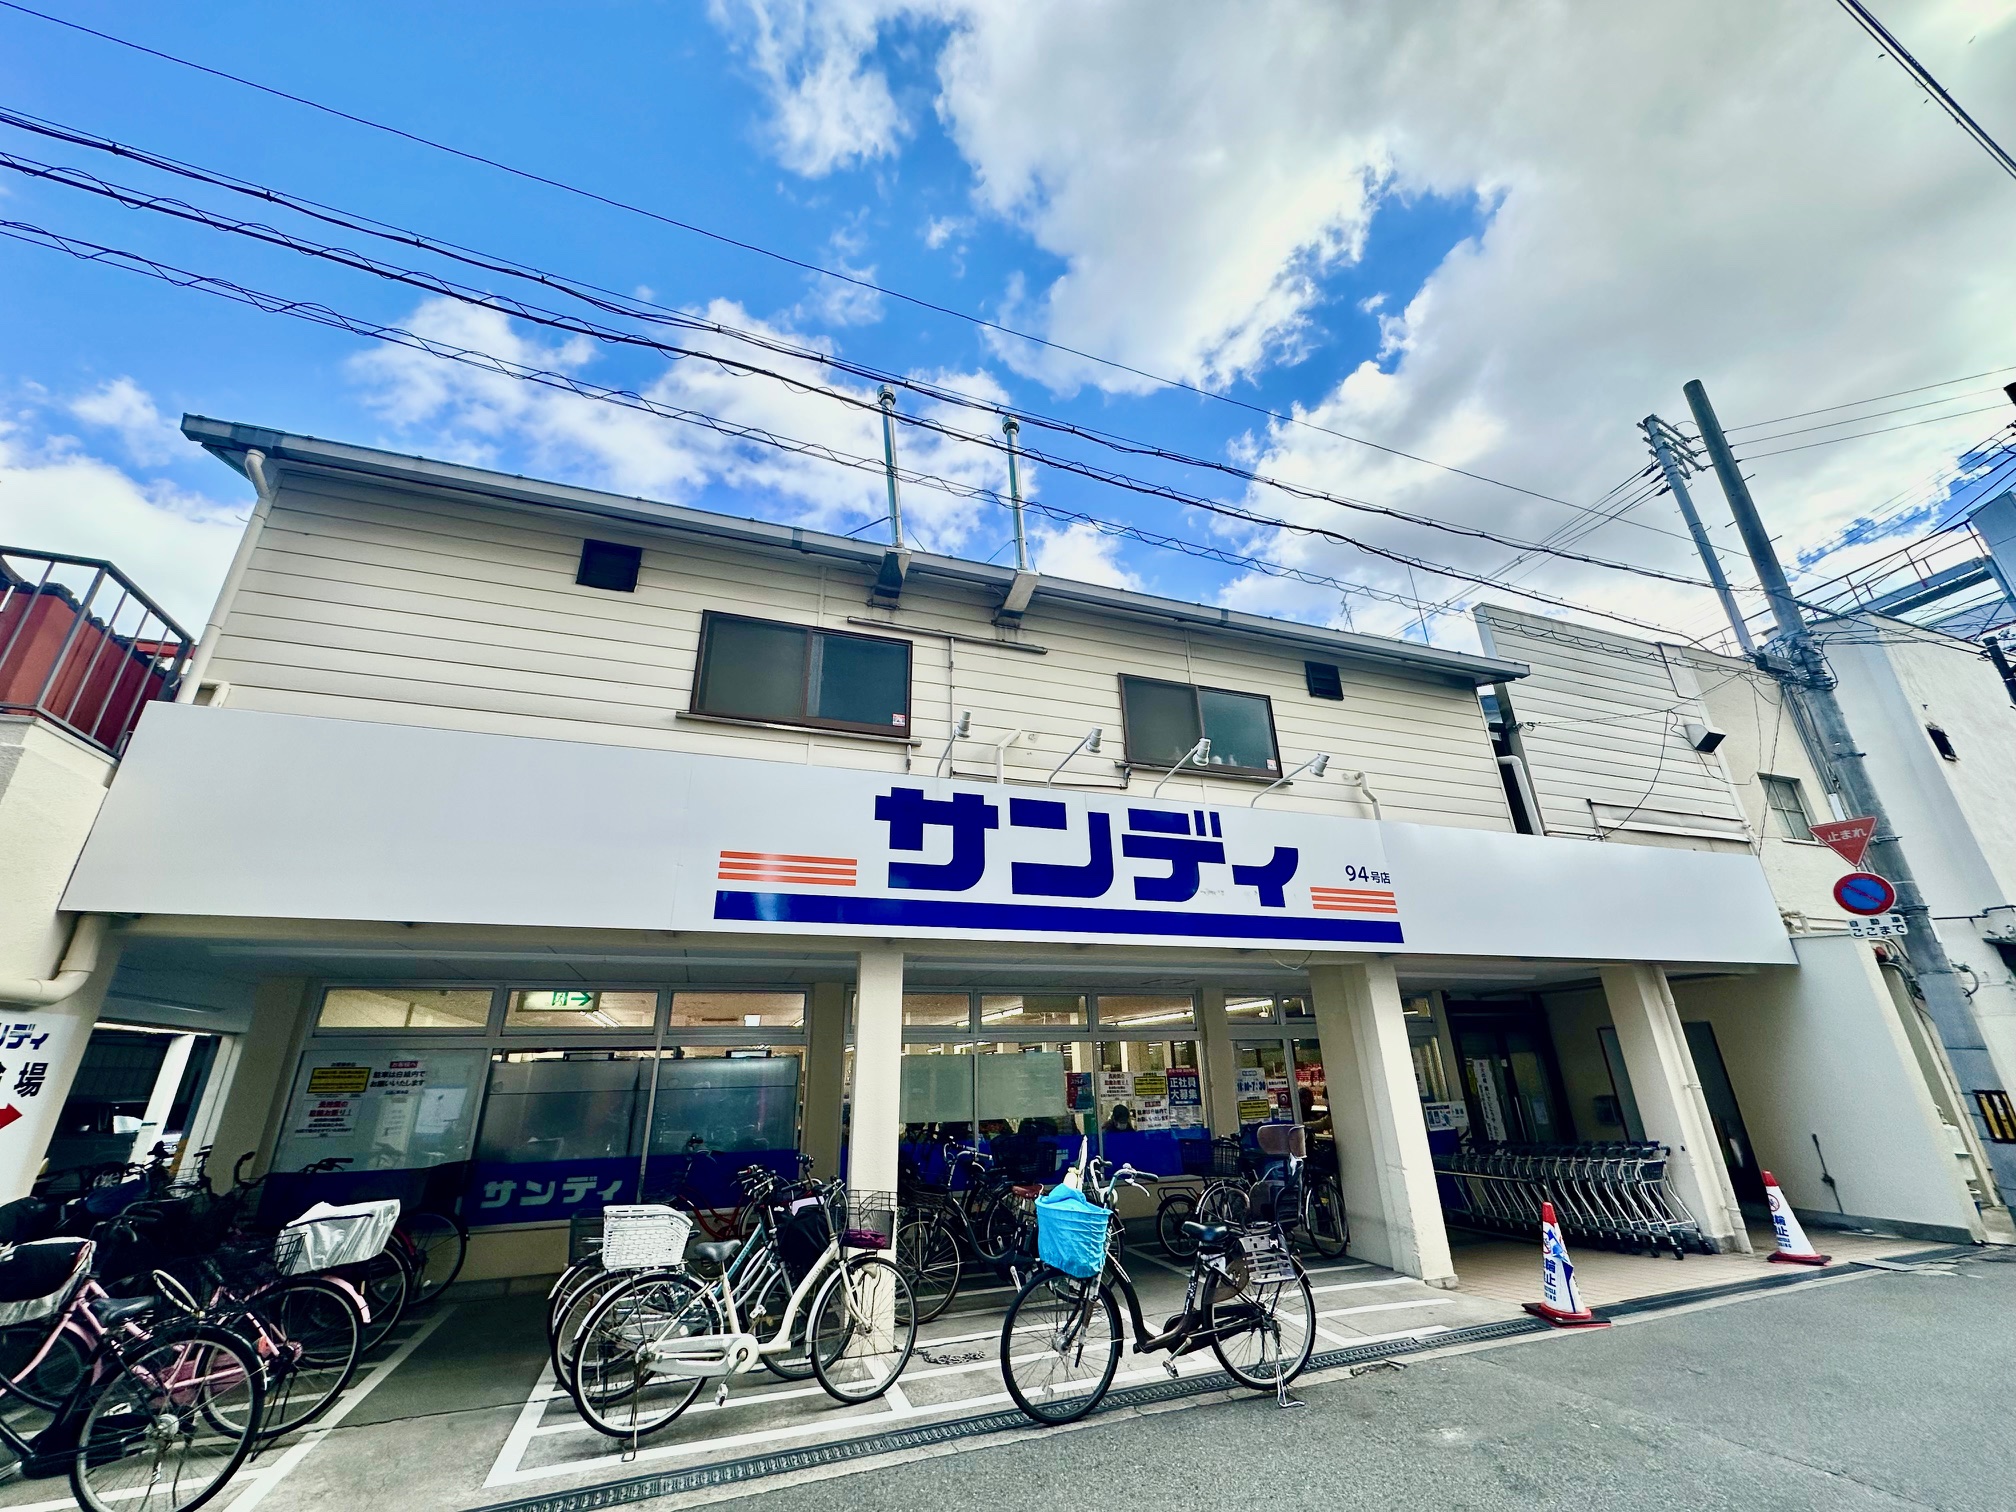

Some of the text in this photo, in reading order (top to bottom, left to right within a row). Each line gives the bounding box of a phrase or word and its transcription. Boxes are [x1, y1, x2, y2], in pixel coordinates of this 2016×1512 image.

[1827, 827, 1868, 842] 止まれ
[874, 786, 1300, 908] サンディ
[1345, 864, 1391, 884] 94号店
[1852, 924, 1905, 937] ここまで
[480, 1175, 623, 1209] サンディ
